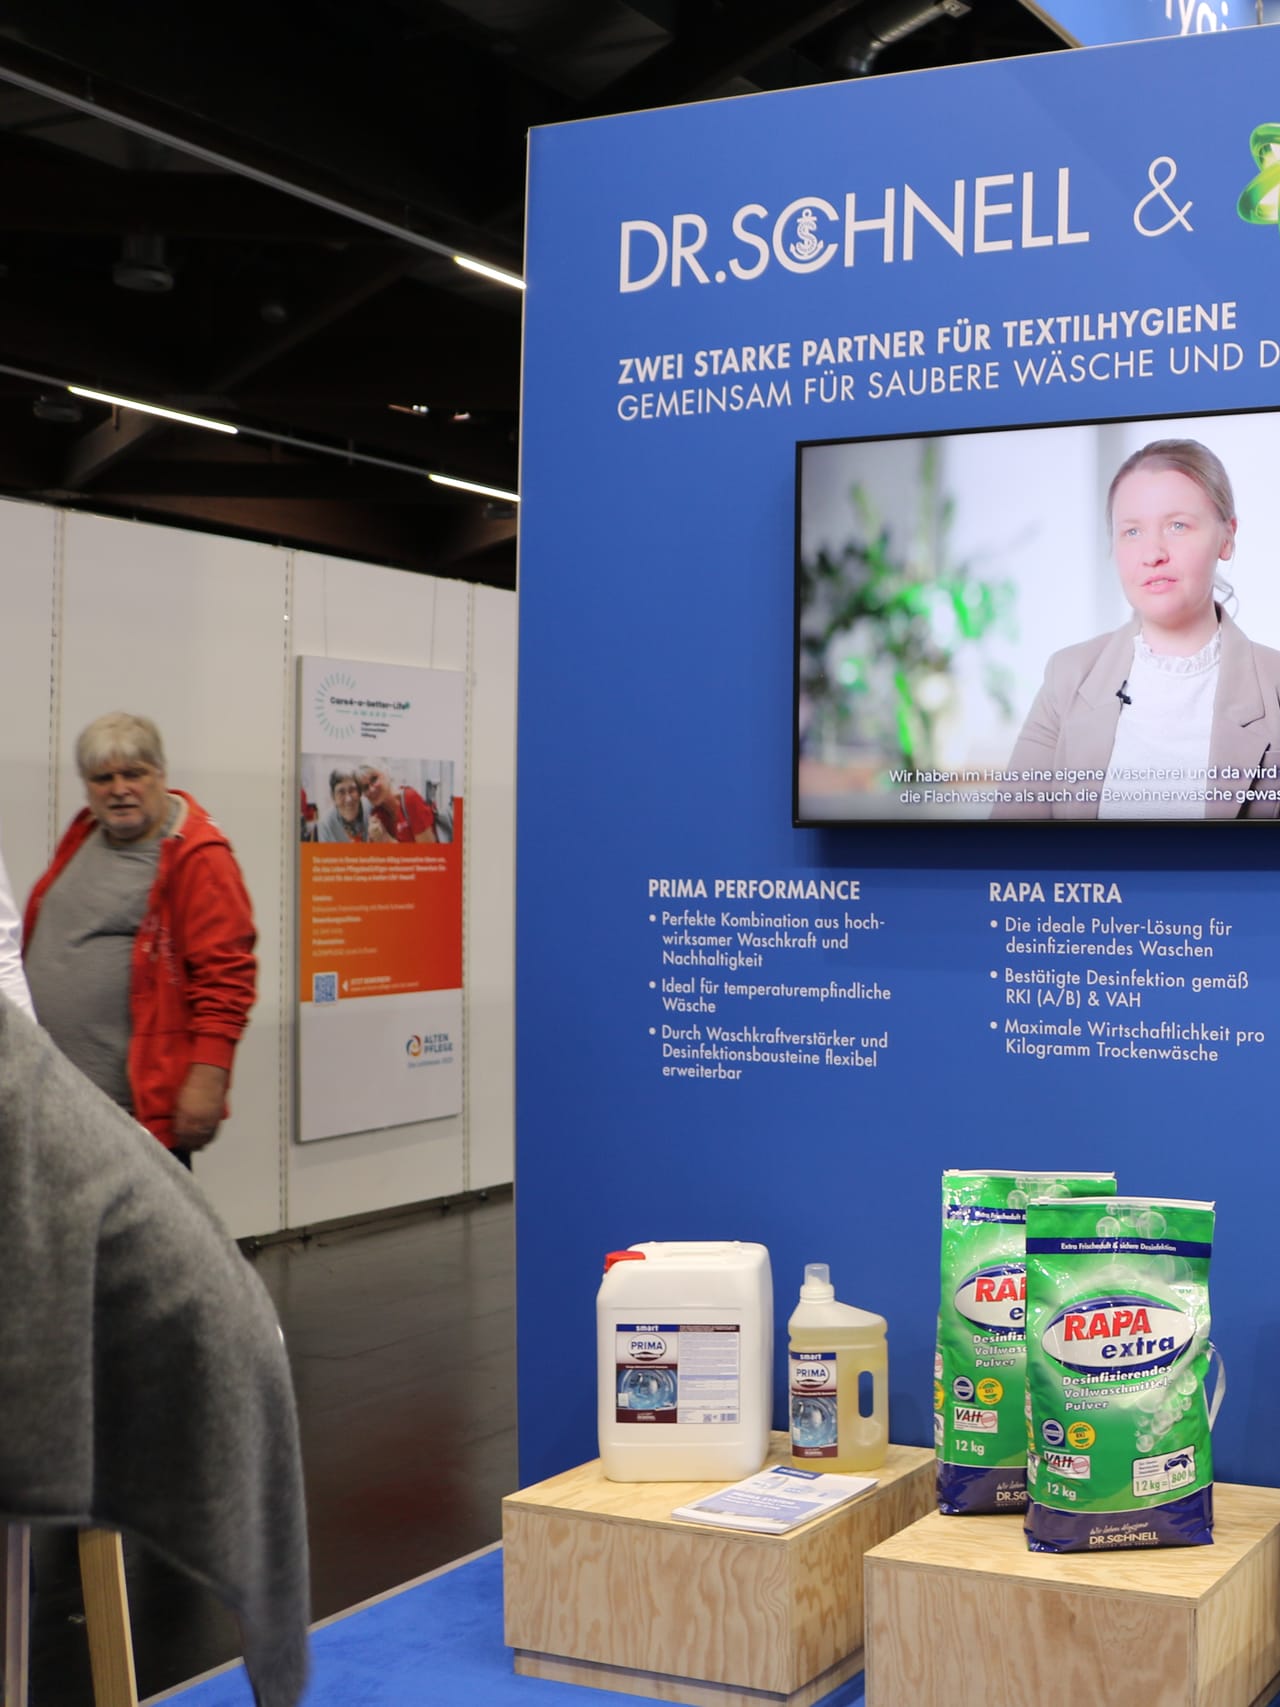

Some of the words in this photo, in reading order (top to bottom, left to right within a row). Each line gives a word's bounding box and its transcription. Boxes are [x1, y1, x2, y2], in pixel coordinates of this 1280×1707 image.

[620, 167, 1089, 293] DR.SCHNELL
[1134, 156, 1193, 237] &
[618, 354, 683, 384] ZWEI
[694, 343, 790, 377] STARKE
[803, 330, 925, 366] PARTNER
[938, 318, 991, 354] FÜR
[1003, 302, 1236, 347] TEXTILHYGIENE
[618, 381, 791, 420] GEMEINSAM
[805, 370, 854, 404] FÜR
[868, 362, 999, 398] SAUBERE
[1014, 349, 1153, 386] WÄSCHE
[1170, 343, 1243, 374] UND
[889, 770, 913, 782] Wir
[916, 770, 958, 782] haben
[963, 770, 979, 781] im
[984, 770, 1019, 781] Haus
[1022, 769, 1052, 781] eine
[1055, 768, 1104, 784] eigene
[1189, 766, 1217, 779] und
[1222, 766, 1240, 778] da
[1243, 765, 1276, 778] wird
[900, 791, 920, 803] die
[1015, 789, 1034, 802] als
[1037, 789, 1072, 802] auch
[1076, 789, 1098, 801] die
[649, 879, 707, 898] PRIMA
[715, 880, 859, 900] PERFORMANCE
[990, 882, 1045, 902] RAPA
[1054, 883, 1122, 903] EXTRA
[663, 910, 716, 926] Perfekte
[721, 911, 809, 928] Kombination
[815, 919, 839, 928] aus
[845, 912, 884, 929] hoch-
[1006, 917, 1031, 932] Die
[1038, 916, 1085, 933] ideale
[1092, 917, 1202, 940] Pulver-Lösung
[1210, 918, 1232, 935] für
[663, 929, 732, 946] wirksamer
[737, 931, 816, 948] Waschkraft
[822, 932, 848, 949] und
[1006, 936, 1133, 955] desinfizierendes
[1139, 939, 1213, 957] Waschen
[663, 949, 763, 971] Nachhaltigkeit
[662, 977, 694, 993] Ideal
[700, 977, 719, 994] für
[724, 981, 891, 1002] temperaturempfindliche
[1005, 968, 1080, 991] Bestätigte
[1087, 969, 1184, 987] Desinfektion
[1192, 971, 1248, 992] gemäß
[662, 996, 716, 1013] Wäsche
[1007, 989, 1030, 1004] RKI
[1038, 986, 1080, 1008] (A/B)
[1088, 991, 1099, 1006] &
[1106, 992, 1140, 1007] VAH
[662, 1024, 701, 1040] Durch
[706, 1026, 856, 1046] Waschkraftverstärker
[861, 1032, 887, 1048] und
[1005, 1019, 1081, 1036] Maximale
[1088, 1021, 1230, 1040] Wirtschaftlichkeit
[1237, 1032, 1264, 1046] pro
[663, 1043, 820, 1064] Desinfektionsbausteine
[825, 1048, 876, 1067] flexibel
[1007, 1037, 1090, 1059] Kilogramm
[1097, 1041, 1218, 1061] Trockenwäsche
[663, 1063, 742, 1079] erweiterbar
[1140, 1243, 1176, 1251] Desinfektion
[1064, 1308, 1152, 1341] RAPA
[631, 1341, 663, 1350] PRIMA
[1102, 1336, 1174, 1359] extra
[796, 1369, 826, 1377] PRIMA
[1063, 1366, 1172, 1385] Desinfizierendes
[1065, 1401, 1108, 1410] Pulver
[956, 1440, 968, 1451] 12
[971, 1440, 984, 1456] kg
[1046, 1453, 1074, 1468] VAH
[1047, 1482, 1059, 1495] 12
[1062, 1485, 1076, 1501] kg
